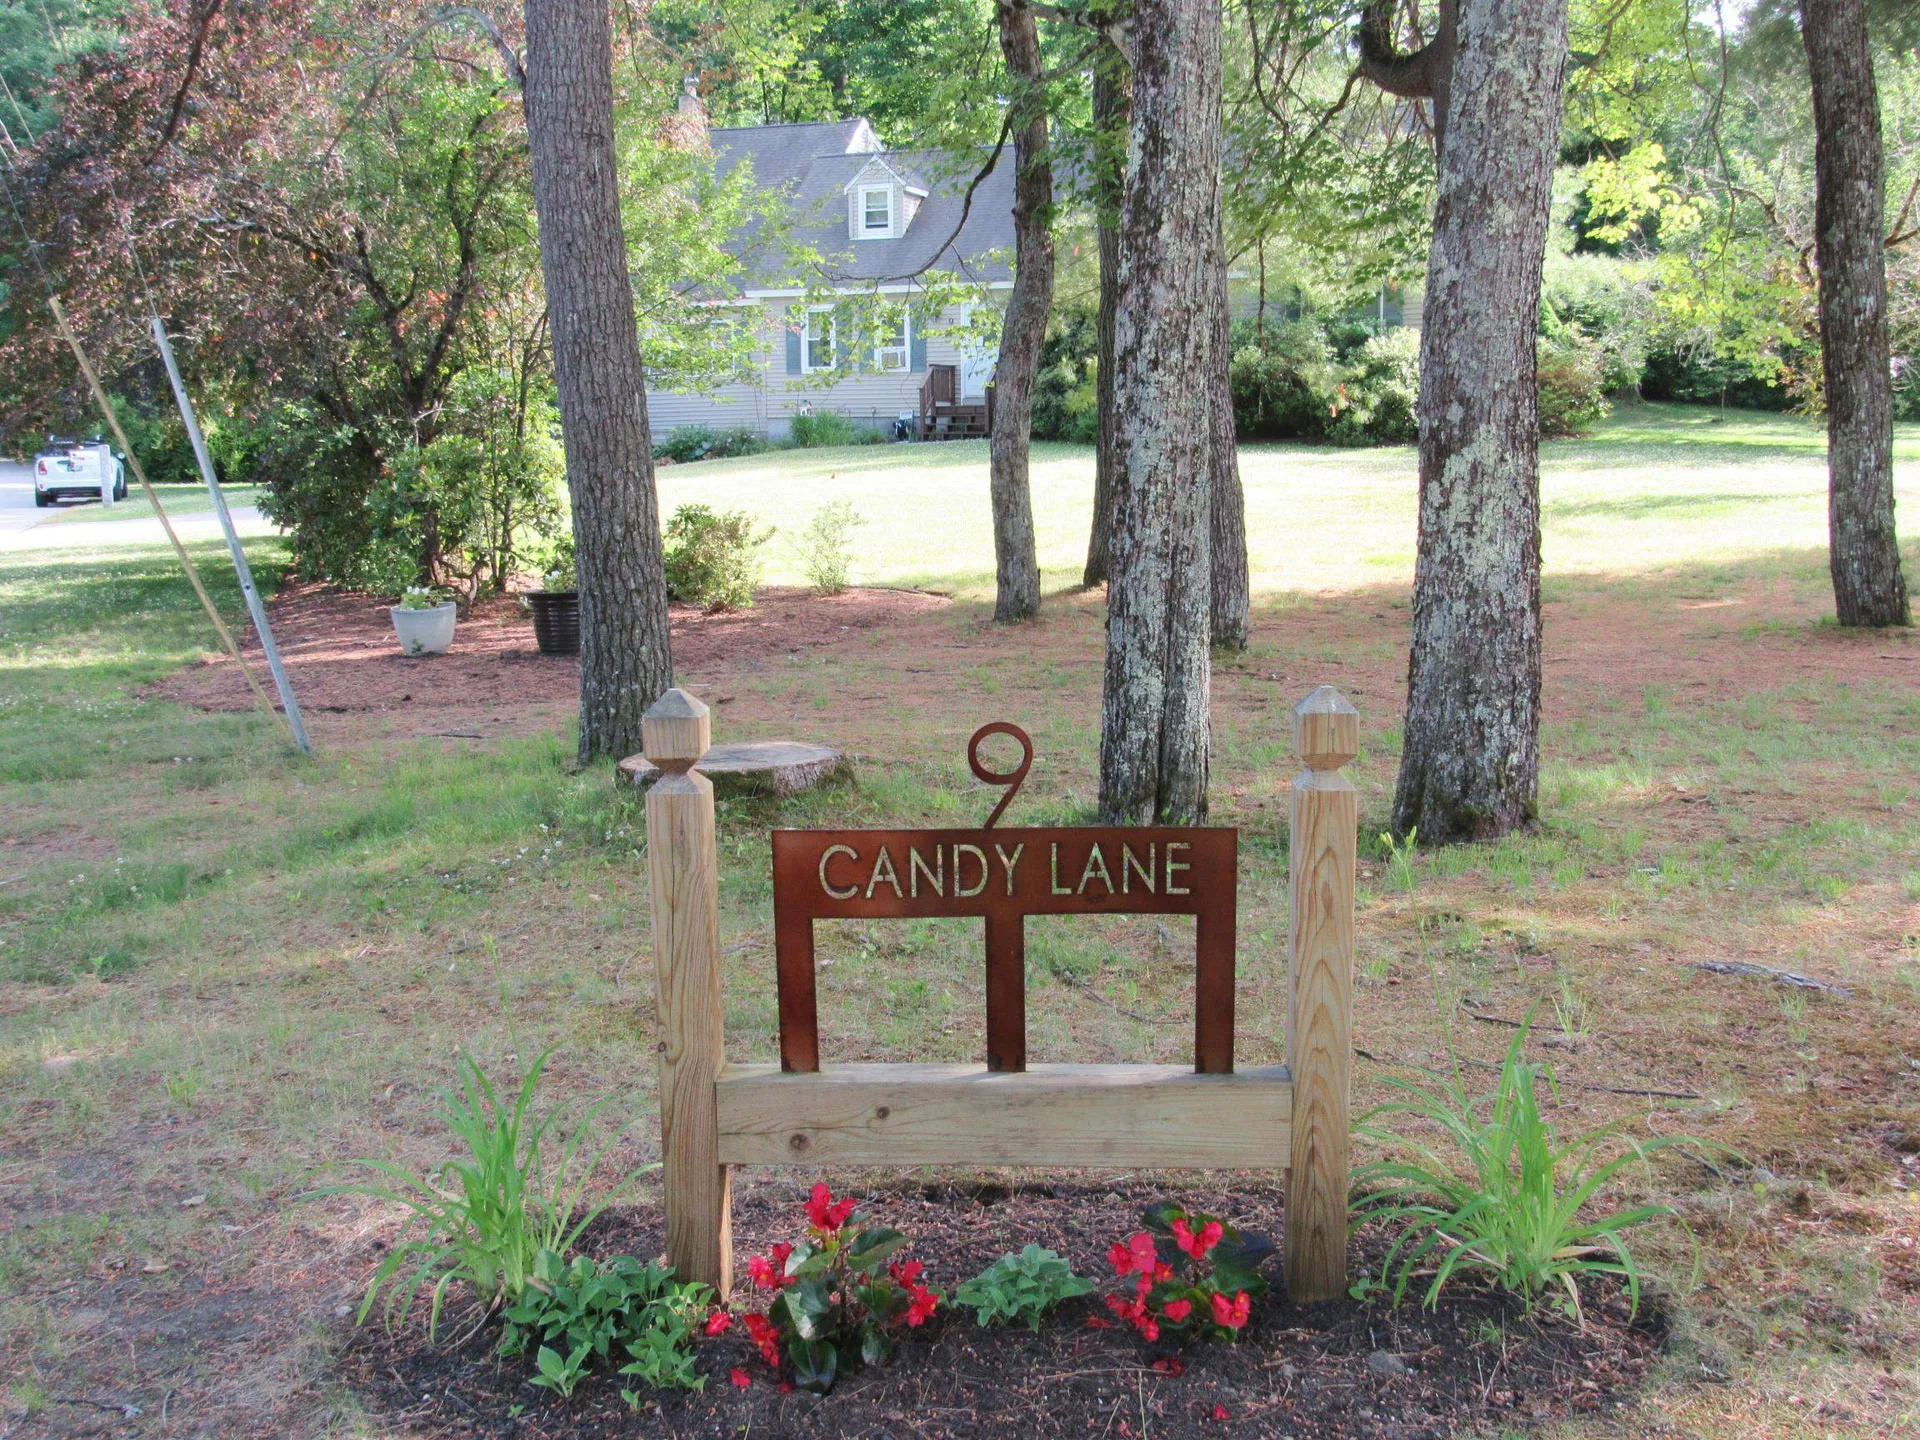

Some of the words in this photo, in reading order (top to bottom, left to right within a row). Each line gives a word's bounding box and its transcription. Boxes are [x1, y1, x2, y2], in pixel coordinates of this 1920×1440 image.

[968, 722, 1033, 829] 9
[818, 843, 1025, 899] CANDY
[1051, 842, 1191, 895] LANE
